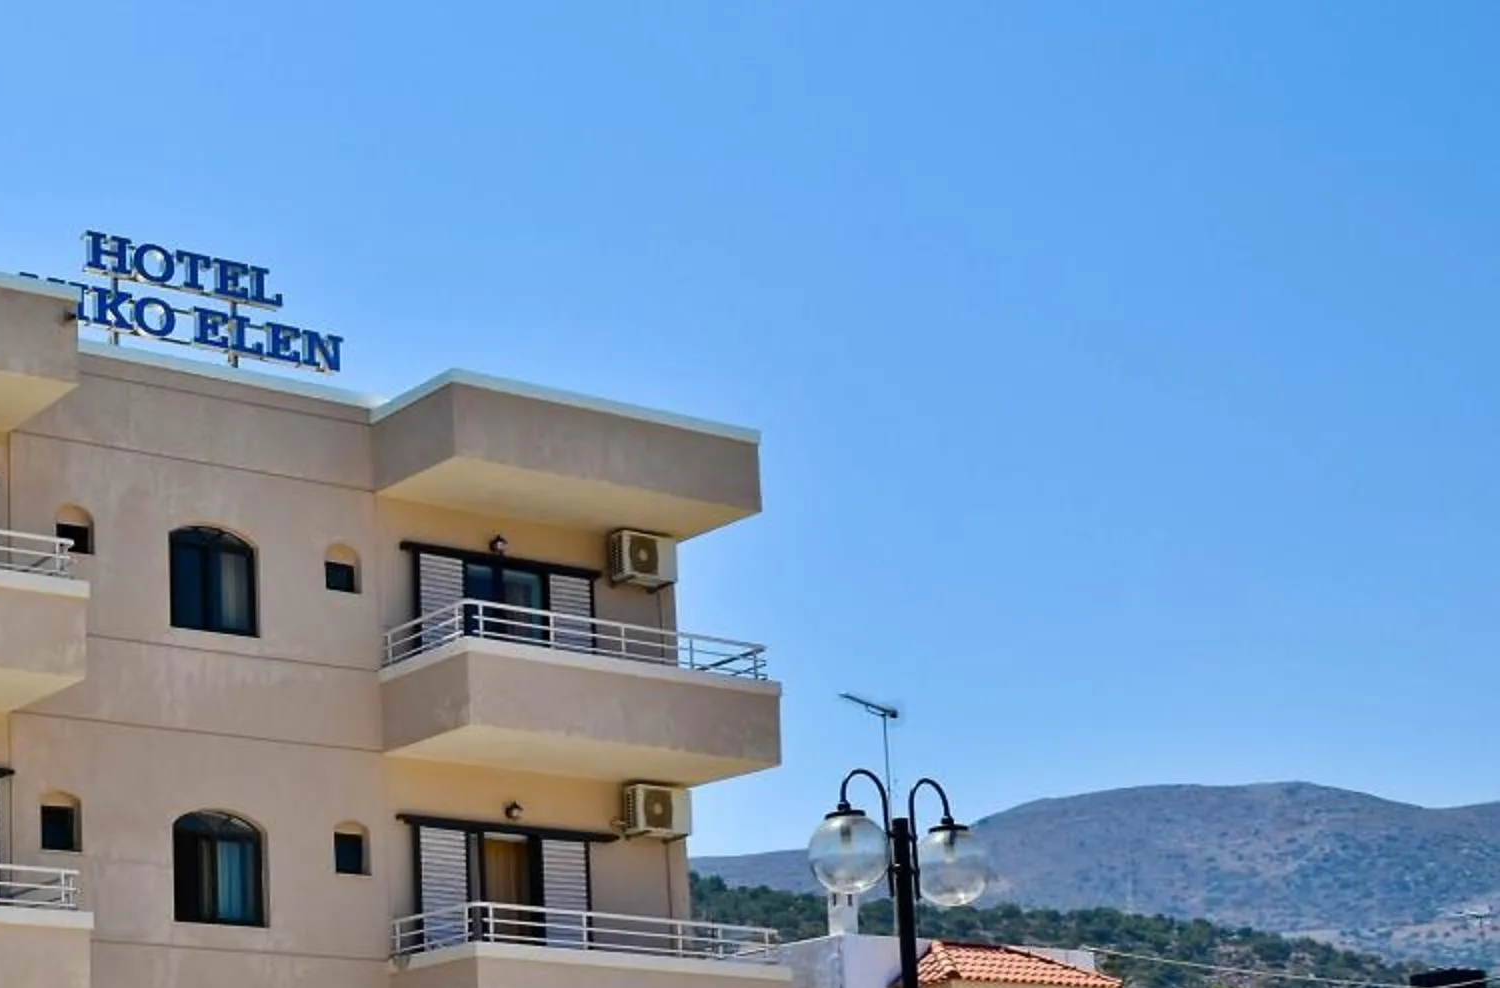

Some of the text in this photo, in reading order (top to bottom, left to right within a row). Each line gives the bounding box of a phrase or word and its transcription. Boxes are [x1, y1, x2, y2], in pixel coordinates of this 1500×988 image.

[82, 229, 284, 308] HOTEL
[19, 271, 345, 372] IKO ELEN
